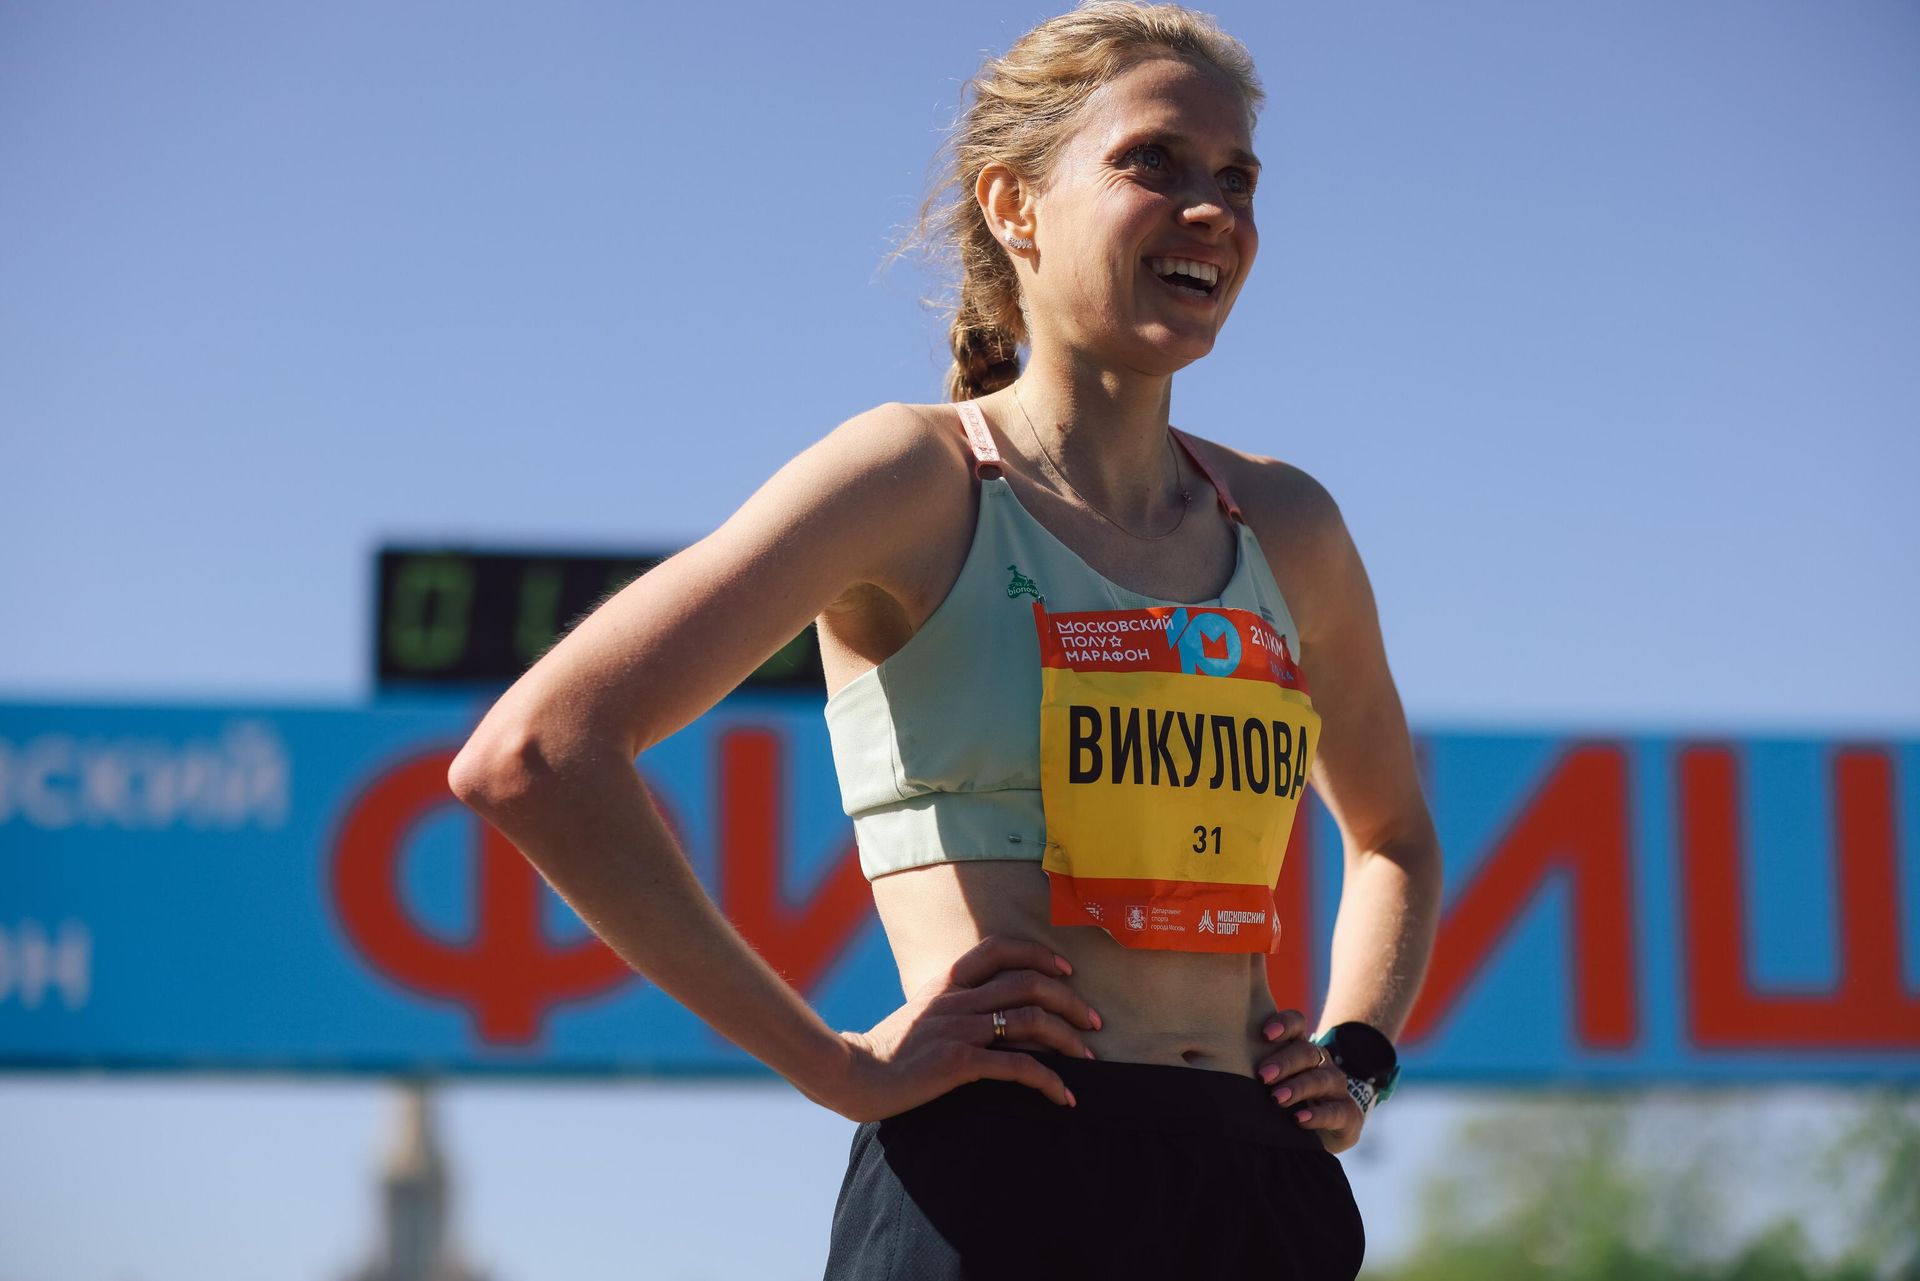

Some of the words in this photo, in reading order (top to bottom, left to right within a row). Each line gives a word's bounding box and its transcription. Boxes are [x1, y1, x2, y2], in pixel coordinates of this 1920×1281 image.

[1056, 615, 1174, 635] МОСКОВСКИЙ
[1066, 648, 1151, 663] МАРАФОН
[1069, 705, 1308, 800] ВИКУЛОВА
[0, 722, 290, 832] СКИЙ
[1192, 825, 1222, 855] 31
[1217, 910, 1266, 925] МОСКОВСКИЙ
[1217, 922, 1240, 935] СПОРТ
